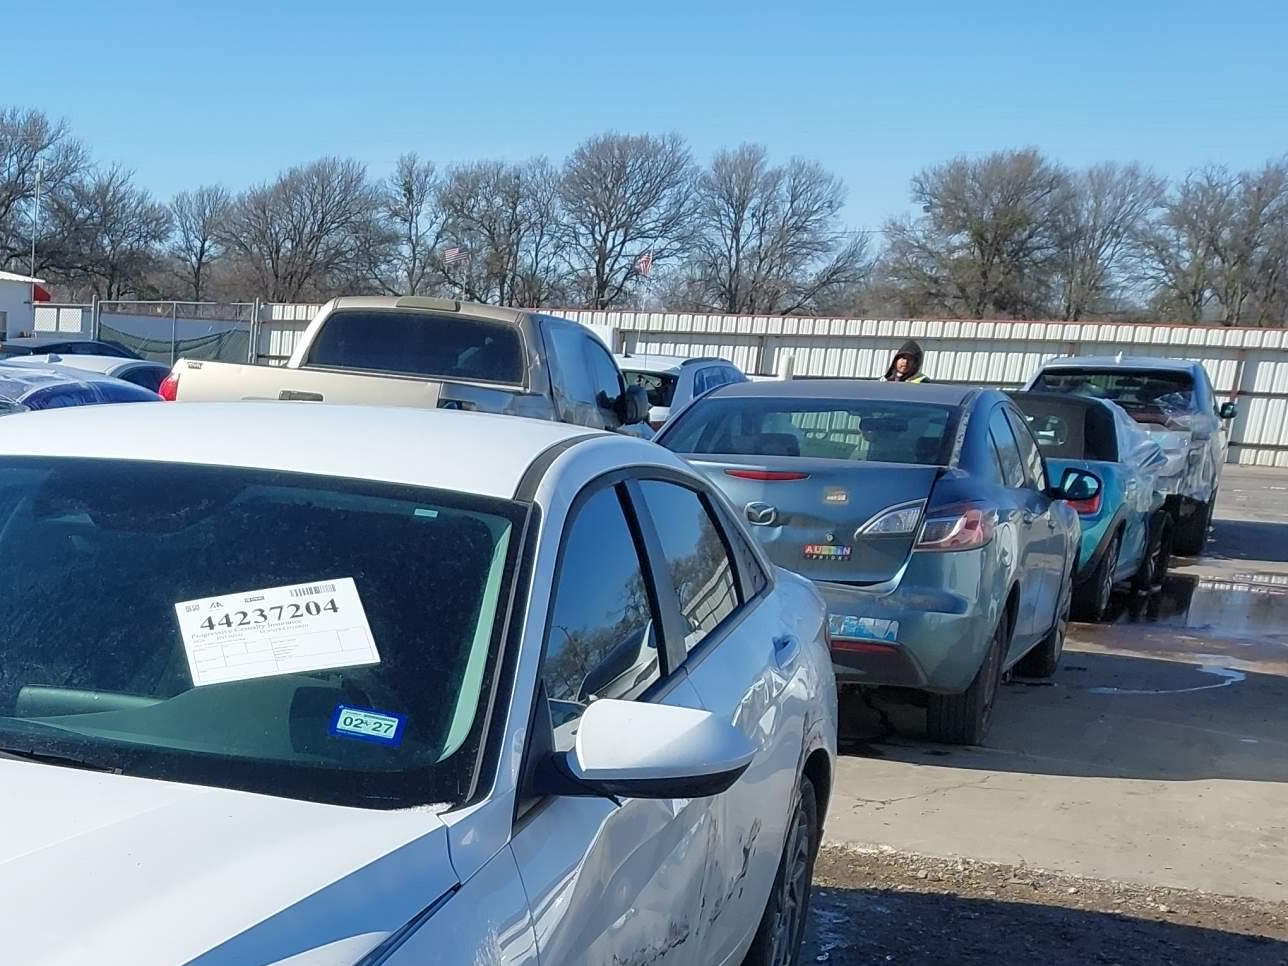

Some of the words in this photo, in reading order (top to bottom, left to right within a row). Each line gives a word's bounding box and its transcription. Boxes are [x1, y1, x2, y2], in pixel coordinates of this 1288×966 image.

[199, 598, 340, 631] 44237204
[342, 716, 364, 729] 02
[371, 721, 394, 734] 27
